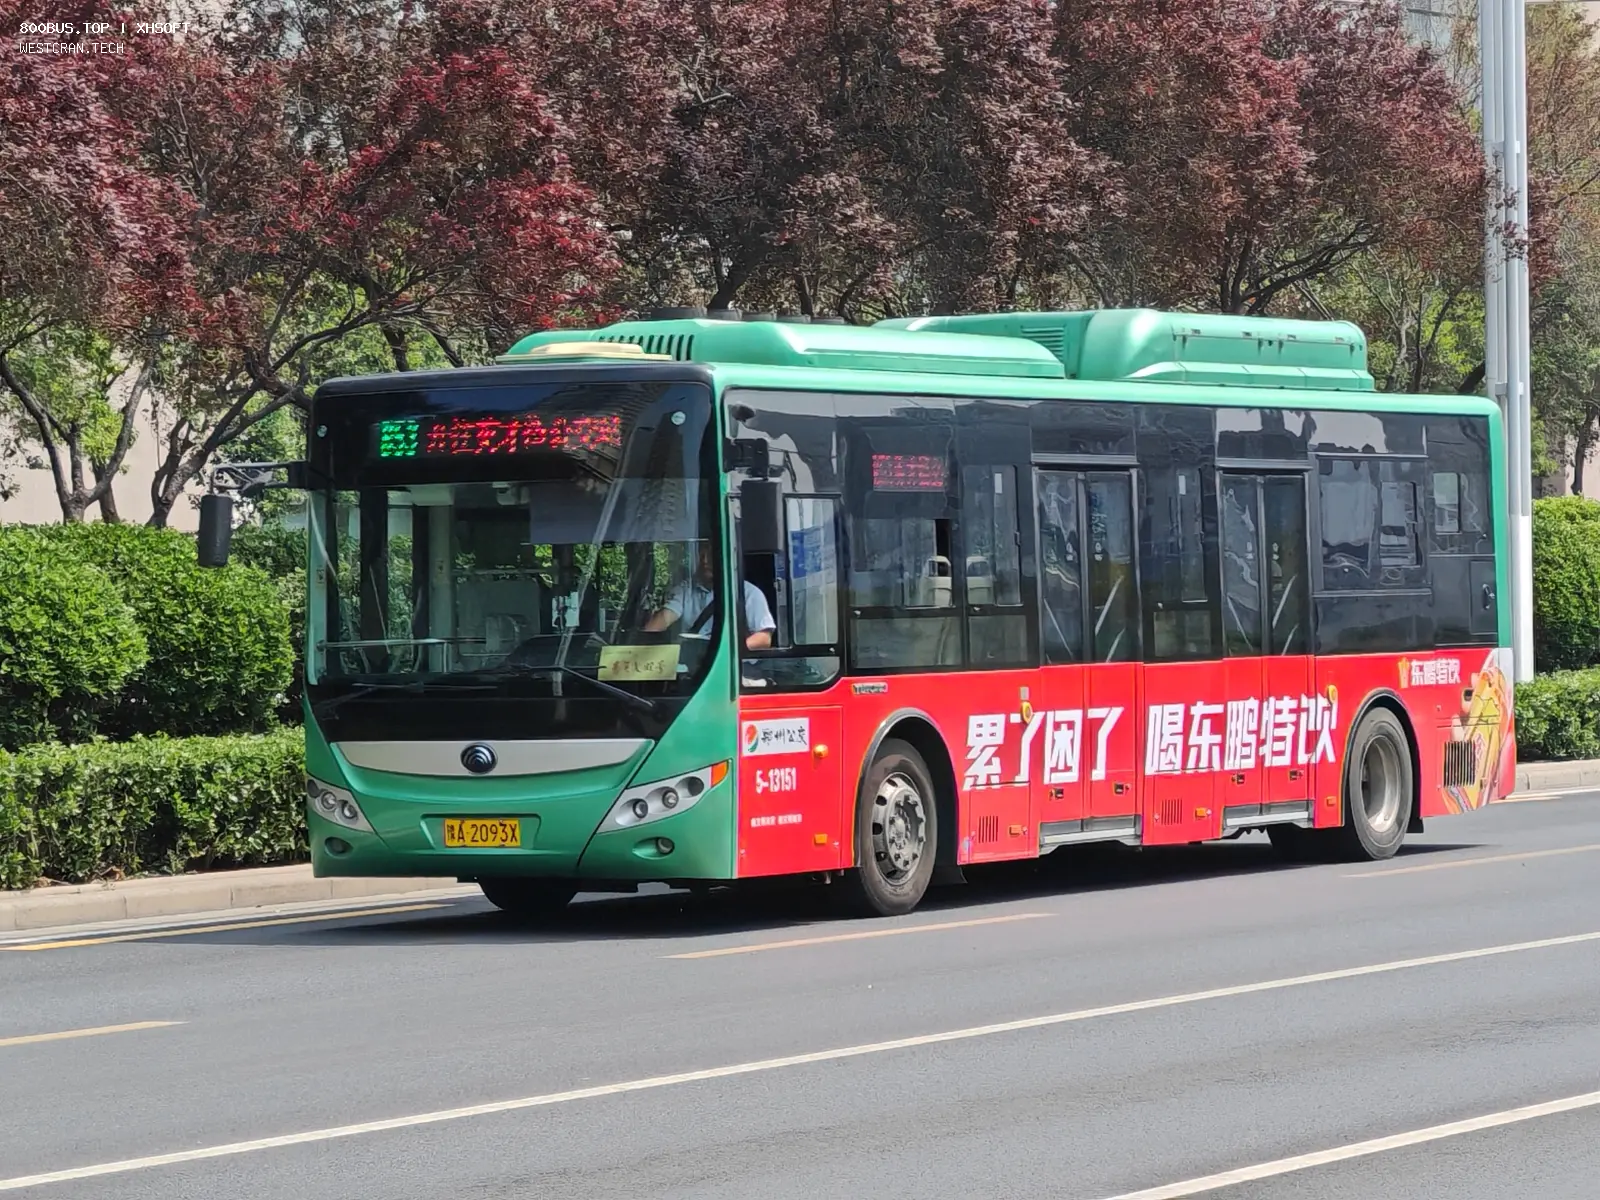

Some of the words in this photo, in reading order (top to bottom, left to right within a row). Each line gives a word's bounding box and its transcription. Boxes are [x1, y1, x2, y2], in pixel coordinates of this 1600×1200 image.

[962, 706, 1125, 792] 累了困了
[1144, 692, 1338, 776] 喝东鹏特饮
[755, 766, 797, 794] 5-13151
